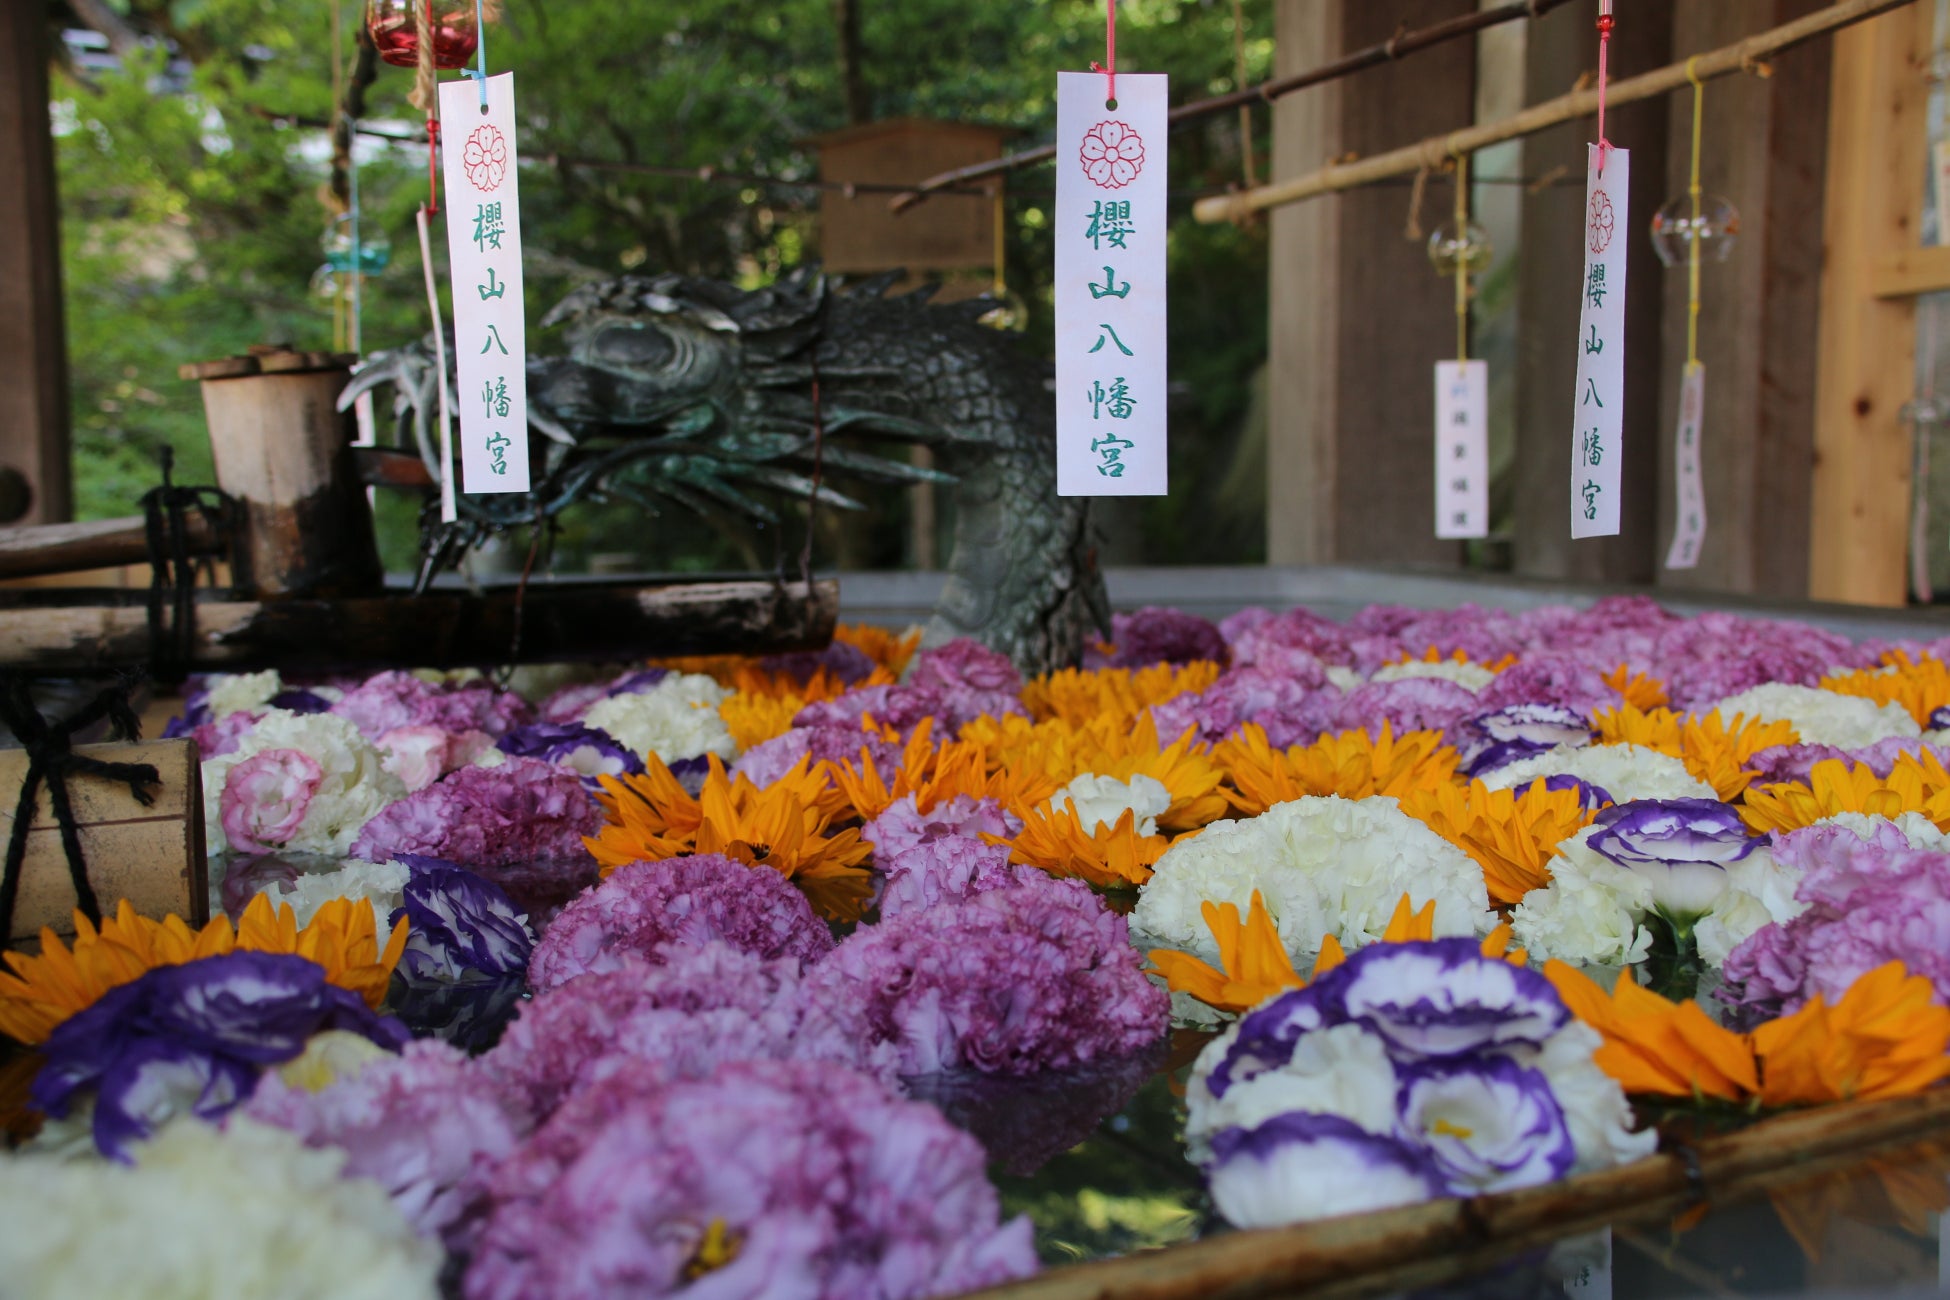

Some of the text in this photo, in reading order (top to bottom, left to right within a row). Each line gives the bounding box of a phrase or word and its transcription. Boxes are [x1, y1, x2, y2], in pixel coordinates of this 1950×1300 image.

[472, 201, 512, 476] 櫻山八幡宮
[1085, 200, 1138, 478] 櫻山八幡宮
[1581, 262, 1607, 520] 櫻山八幡宮
